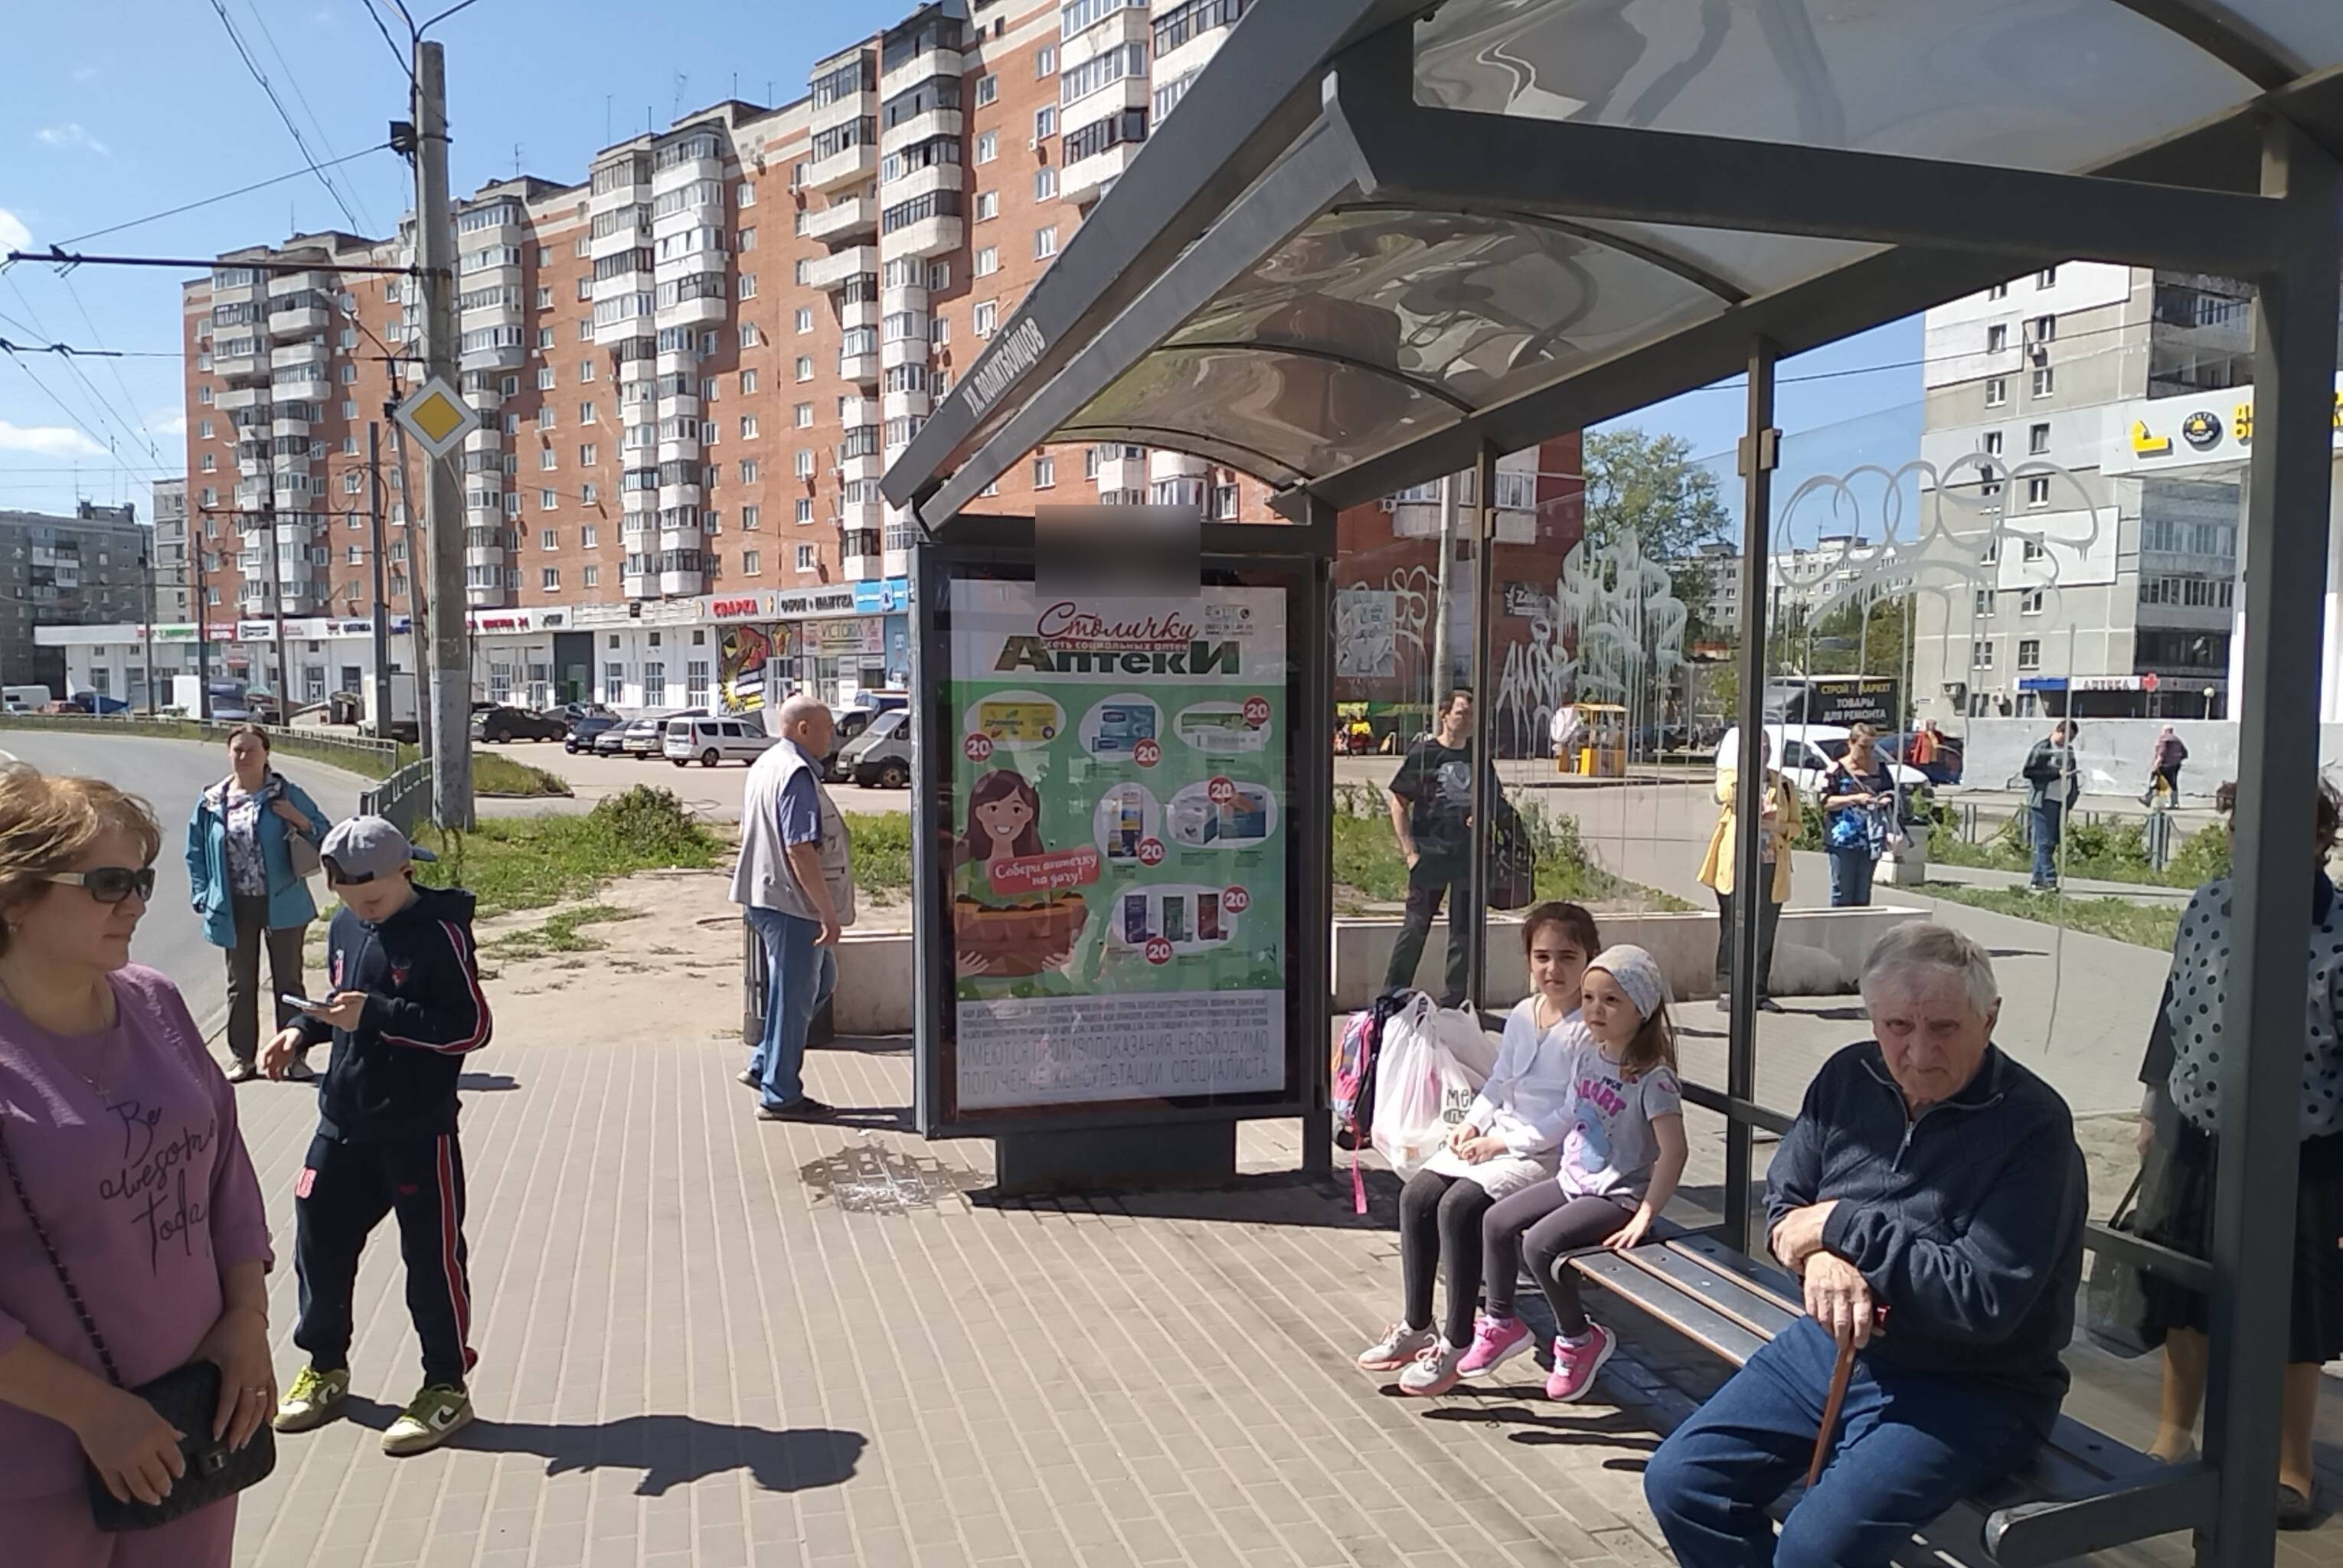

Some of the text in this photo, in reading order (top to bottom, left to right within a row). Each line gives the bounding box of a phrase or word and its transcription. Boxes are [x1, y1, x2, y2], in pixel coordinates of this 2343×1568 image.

[973, 317, 1046, 404] ПОЛИТБОЙЦОВ
[713, 599, 759, 617] СВАРКА
[1037, 602, 1199, 639] Столички
[1837, 697, 1875, 708] ТОВАРЫ
[1247, 703, 1268, 719] 20
[1823, 709, 1887, 723] ДЛЯ РЕМОНТА
[967, 740, 990, 756] 20
[1137, 746, 1158, 762] 20
[1212, 782, 1232, 799] 20
[1142, 844, 1163, 860] 20
[995, 862, 1041, 880] Собери
[1031, 876, 1047, 886] на
[1225, 892, 1247, 907] 20
[1149, 945, 1170, 959] 20
[1179, 1030, 1270, 1056] НЕОБХОДИМО
[1172, 1057, 1269, 1084] СПЕЦИАЛИСТА
[1577, 1079, 1627, 1117] EART
[106, 1101, 162, 1169] Be
